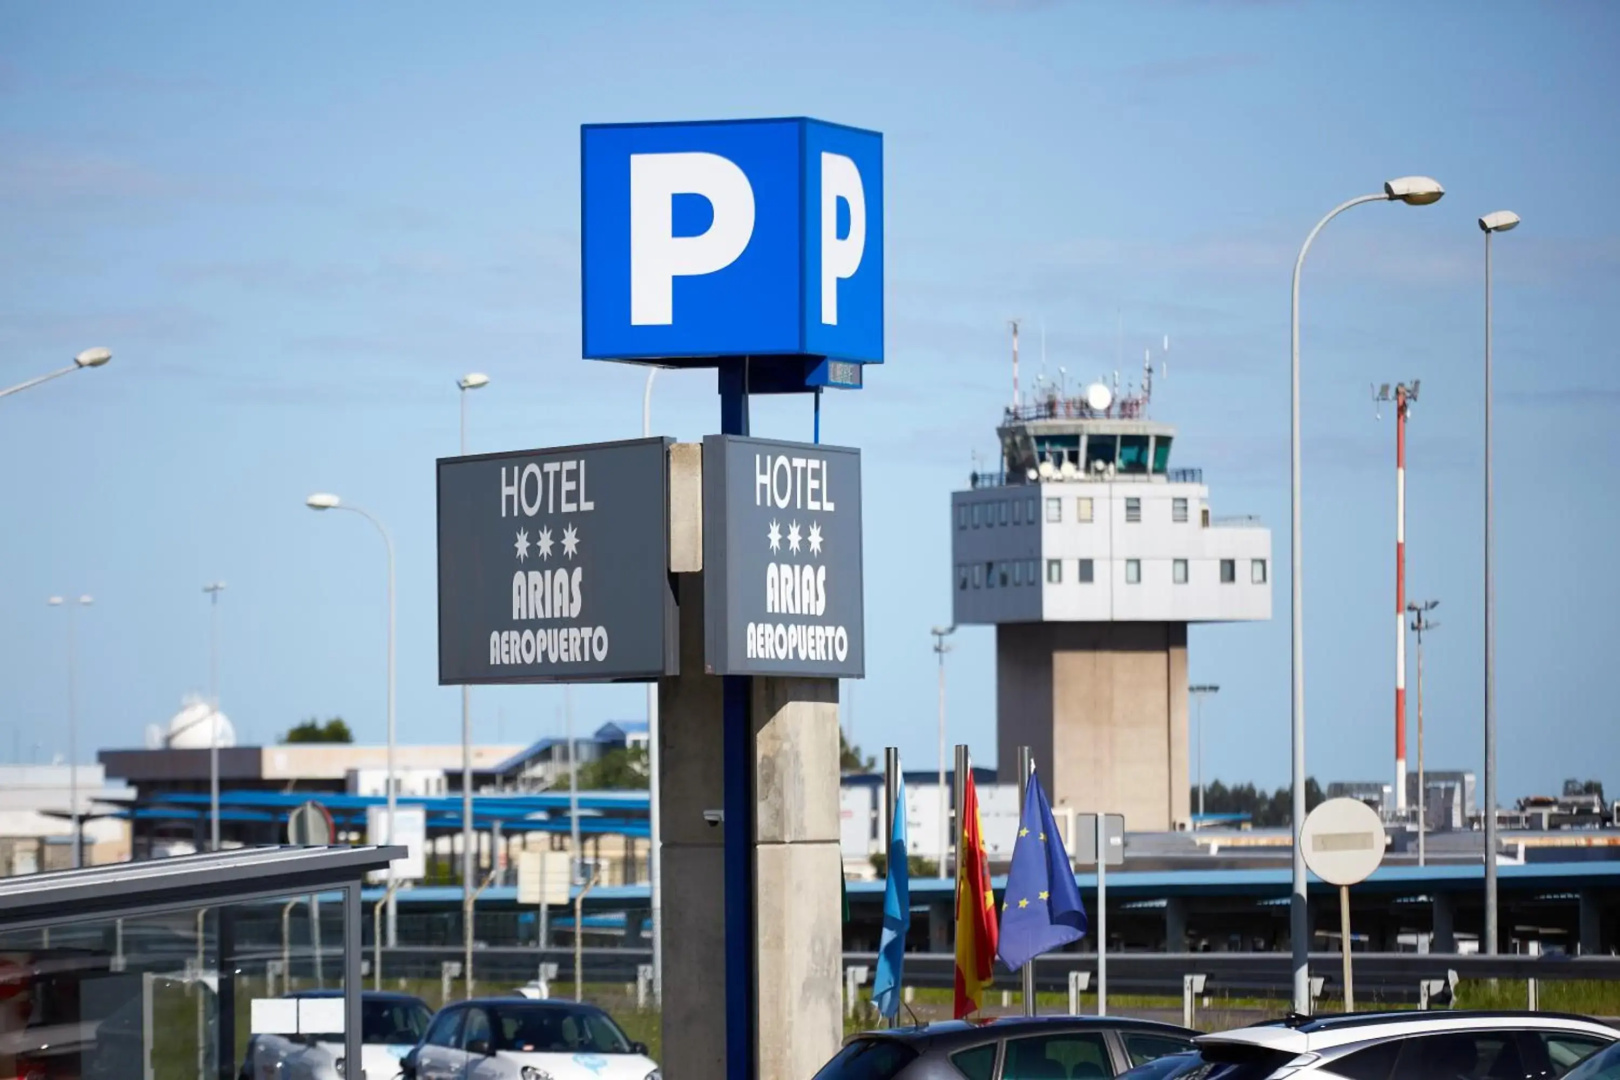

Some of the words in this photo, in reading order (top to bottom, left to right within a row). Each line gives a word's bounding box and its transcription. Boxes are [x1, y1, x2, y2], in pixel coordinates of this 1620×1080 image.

[630, 152, 755, 326] P
[821, 151, 866, 326] P
[501, 459, 595, 518] HOTEL
[755, 453, 835, 512] HOTEL
[512, 566, 583, 620] ARIAS
[766, 562, 826, 617] ARIAS
[489, 625, 609, 665] AEROPUERTO
[746, 621, 849, 662] AEROPUERTO
